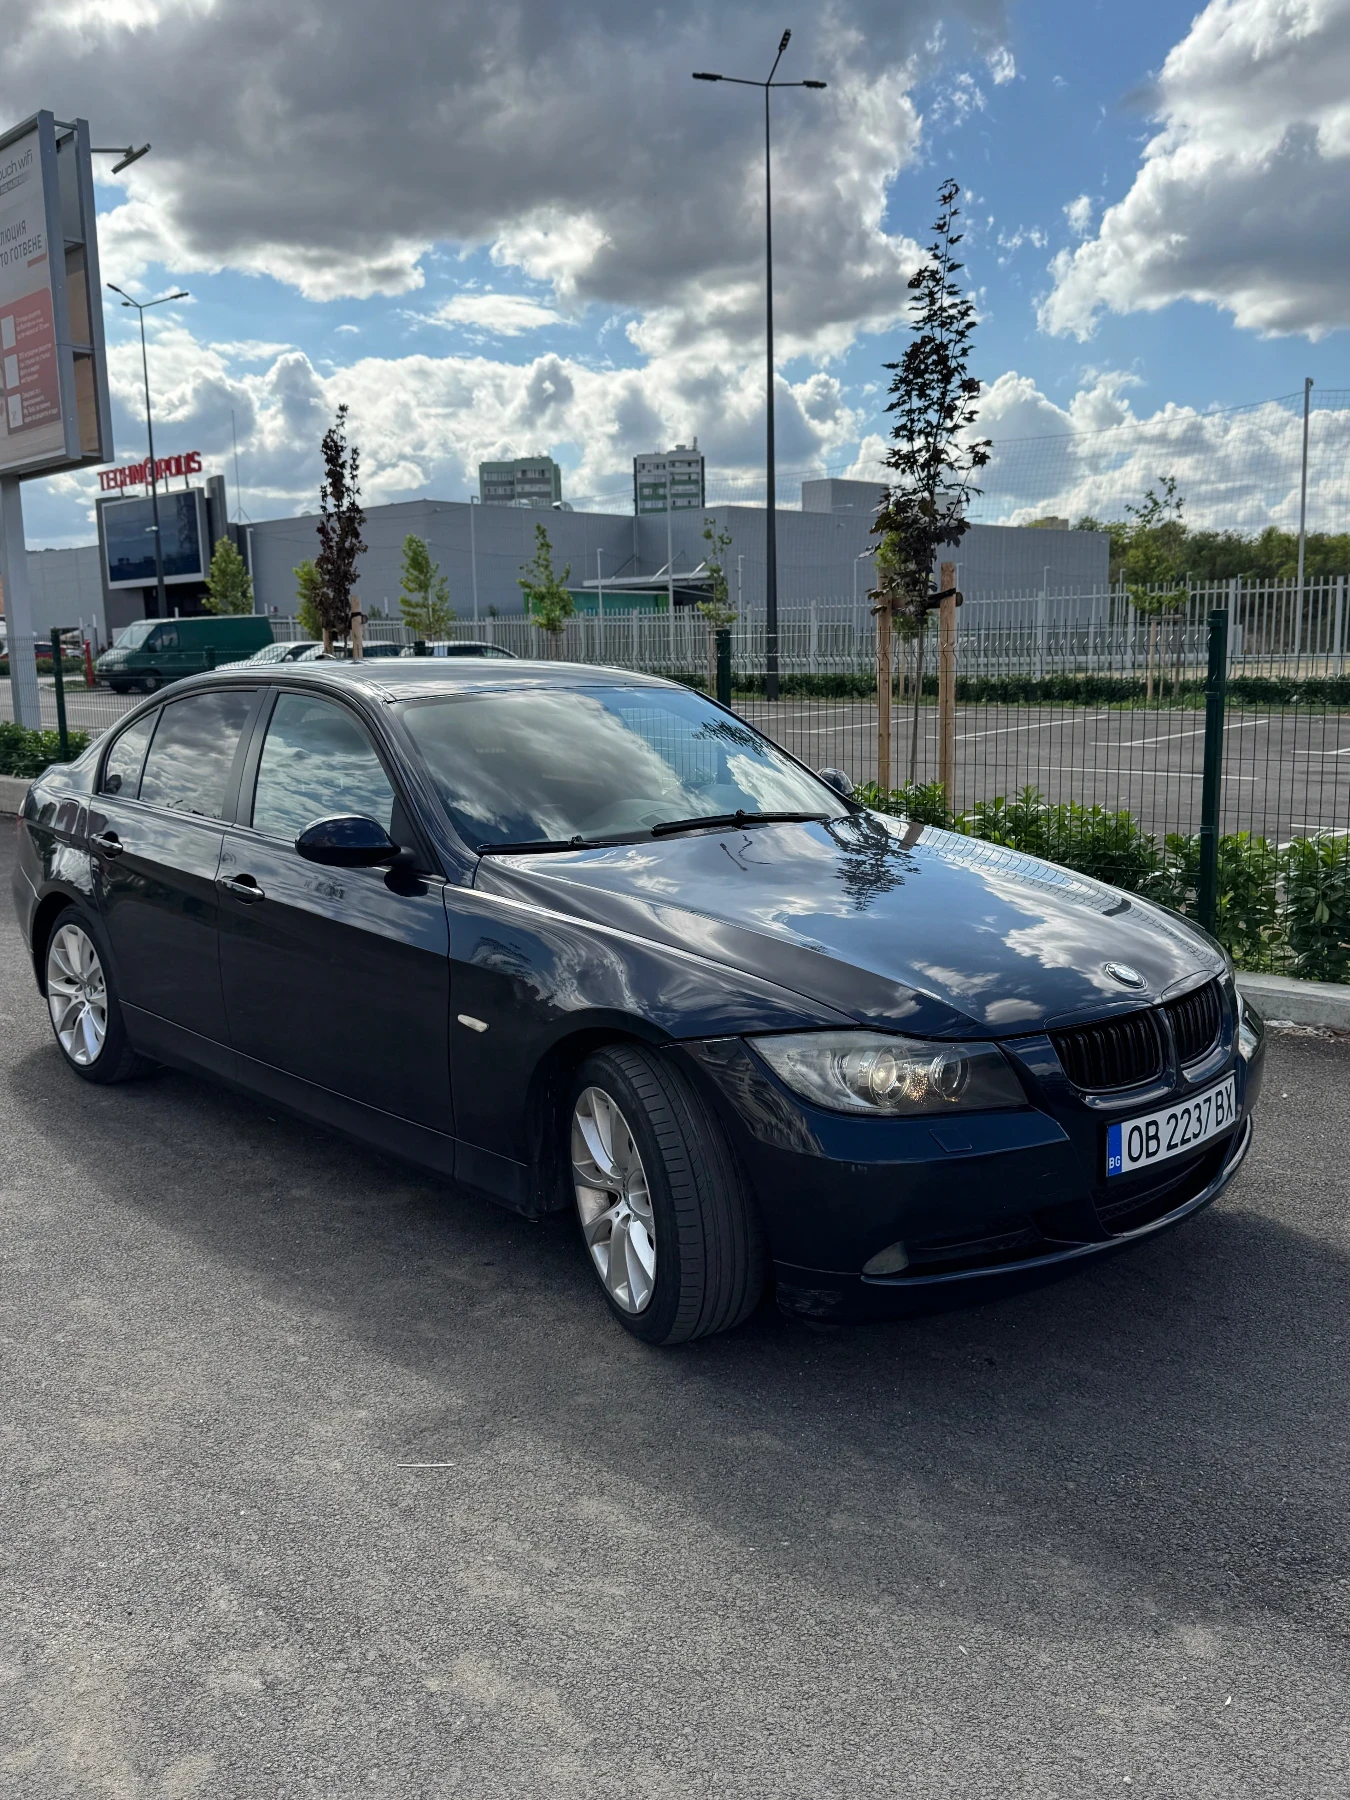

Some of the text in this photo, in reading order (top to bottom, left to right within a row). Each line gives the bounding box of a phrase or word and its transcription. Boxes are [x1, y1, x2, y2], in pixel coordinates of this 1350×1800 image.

[10, 234, 42, 263] ГОТВЕНЕ
[97, 451, 202, 491] TECHNOPOLIS
[1127, 1082, 1233, 1162] OB 2237 BX
[1109, 1155, 1121, 1169] BG
